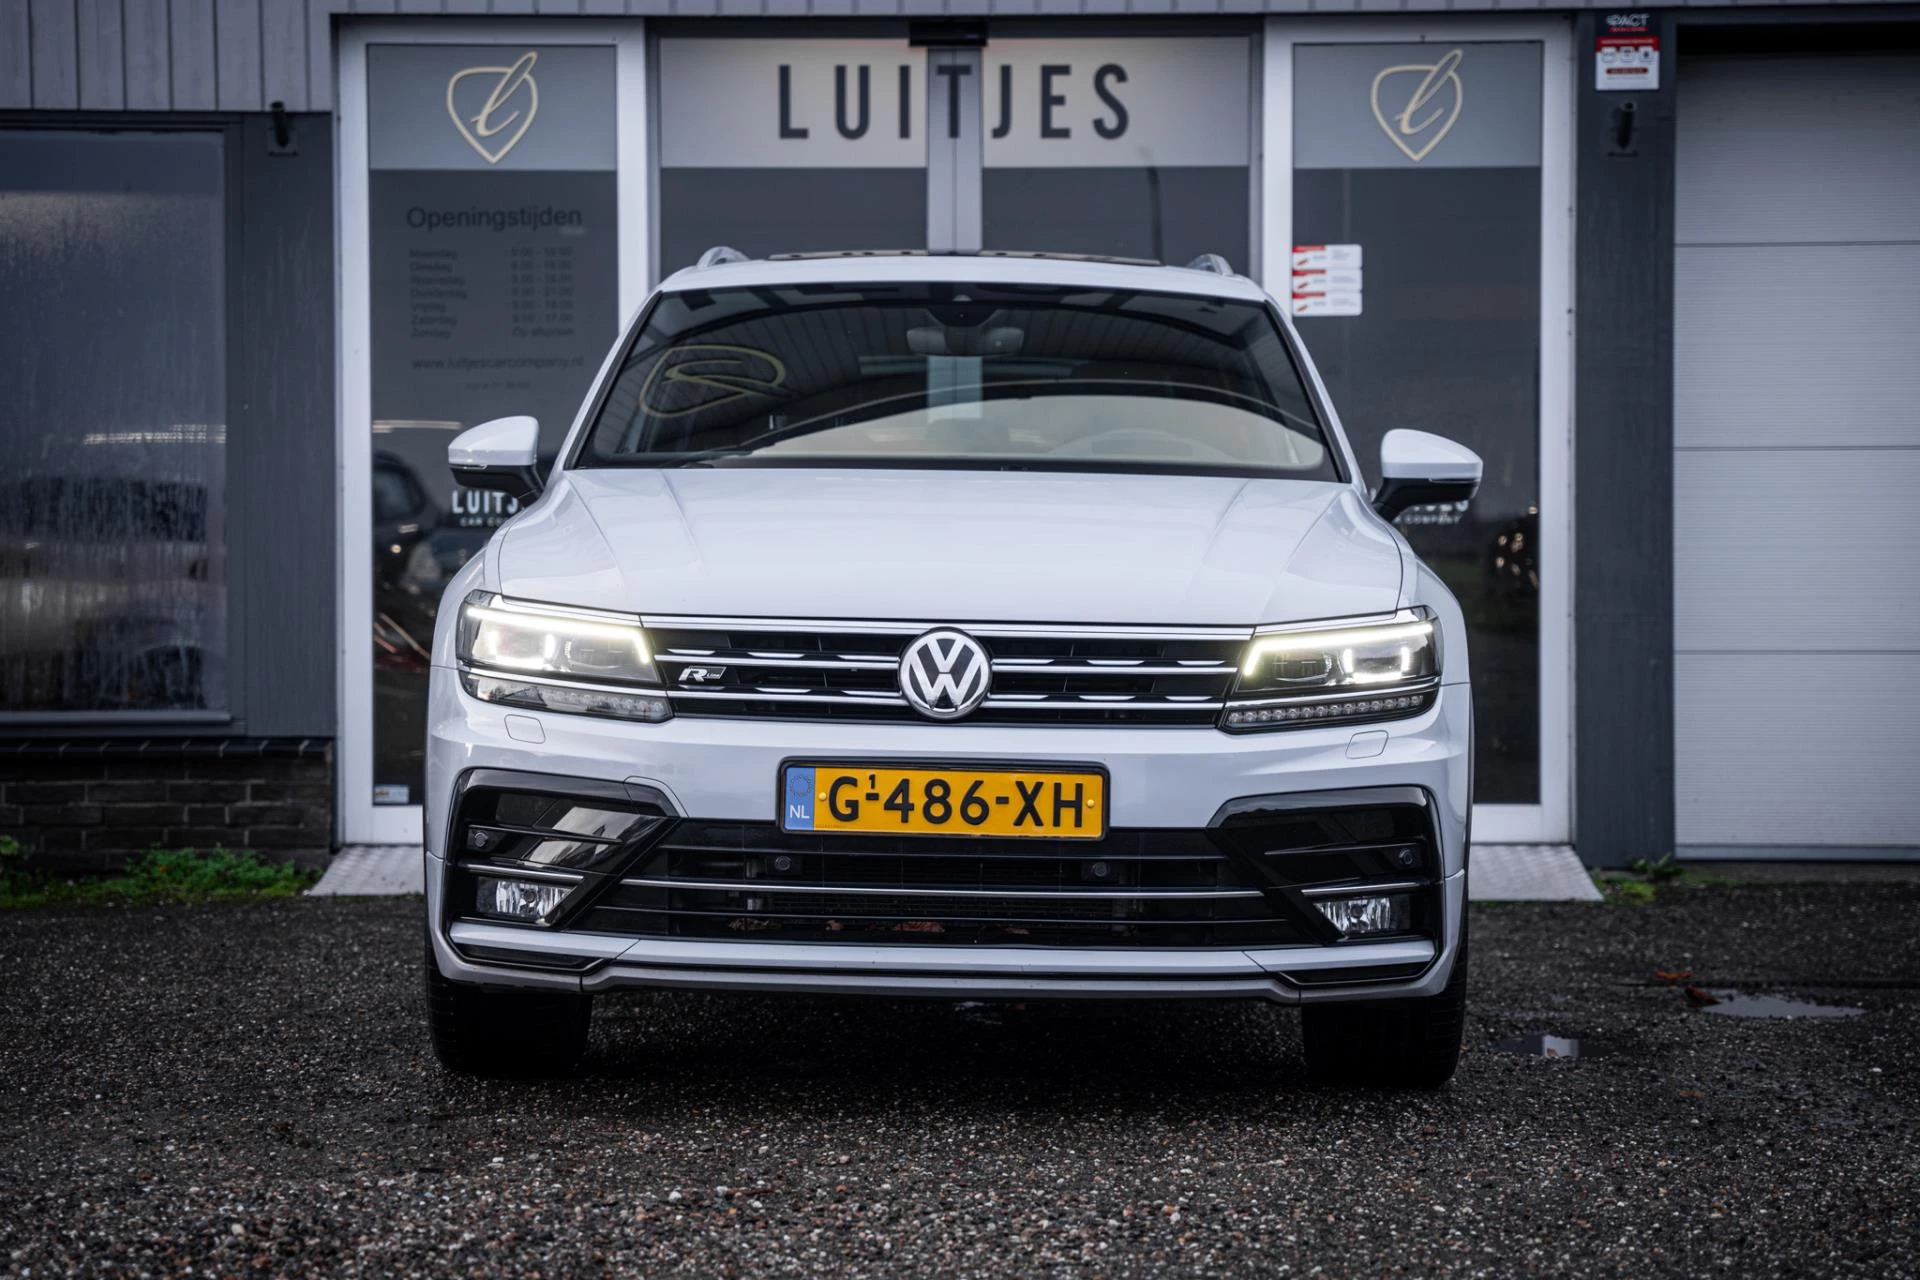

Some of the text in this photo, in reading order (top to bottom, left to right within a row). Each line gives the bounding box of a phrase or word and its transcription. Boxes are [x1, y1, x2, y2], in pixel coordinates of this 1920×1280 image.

[778, 63, 1129, 140] LUITJES
[406, 204, 583, 232] Openingstijden
[452, 490, 518, 514] LUITJ
[789, 804, 810, 819] NL
